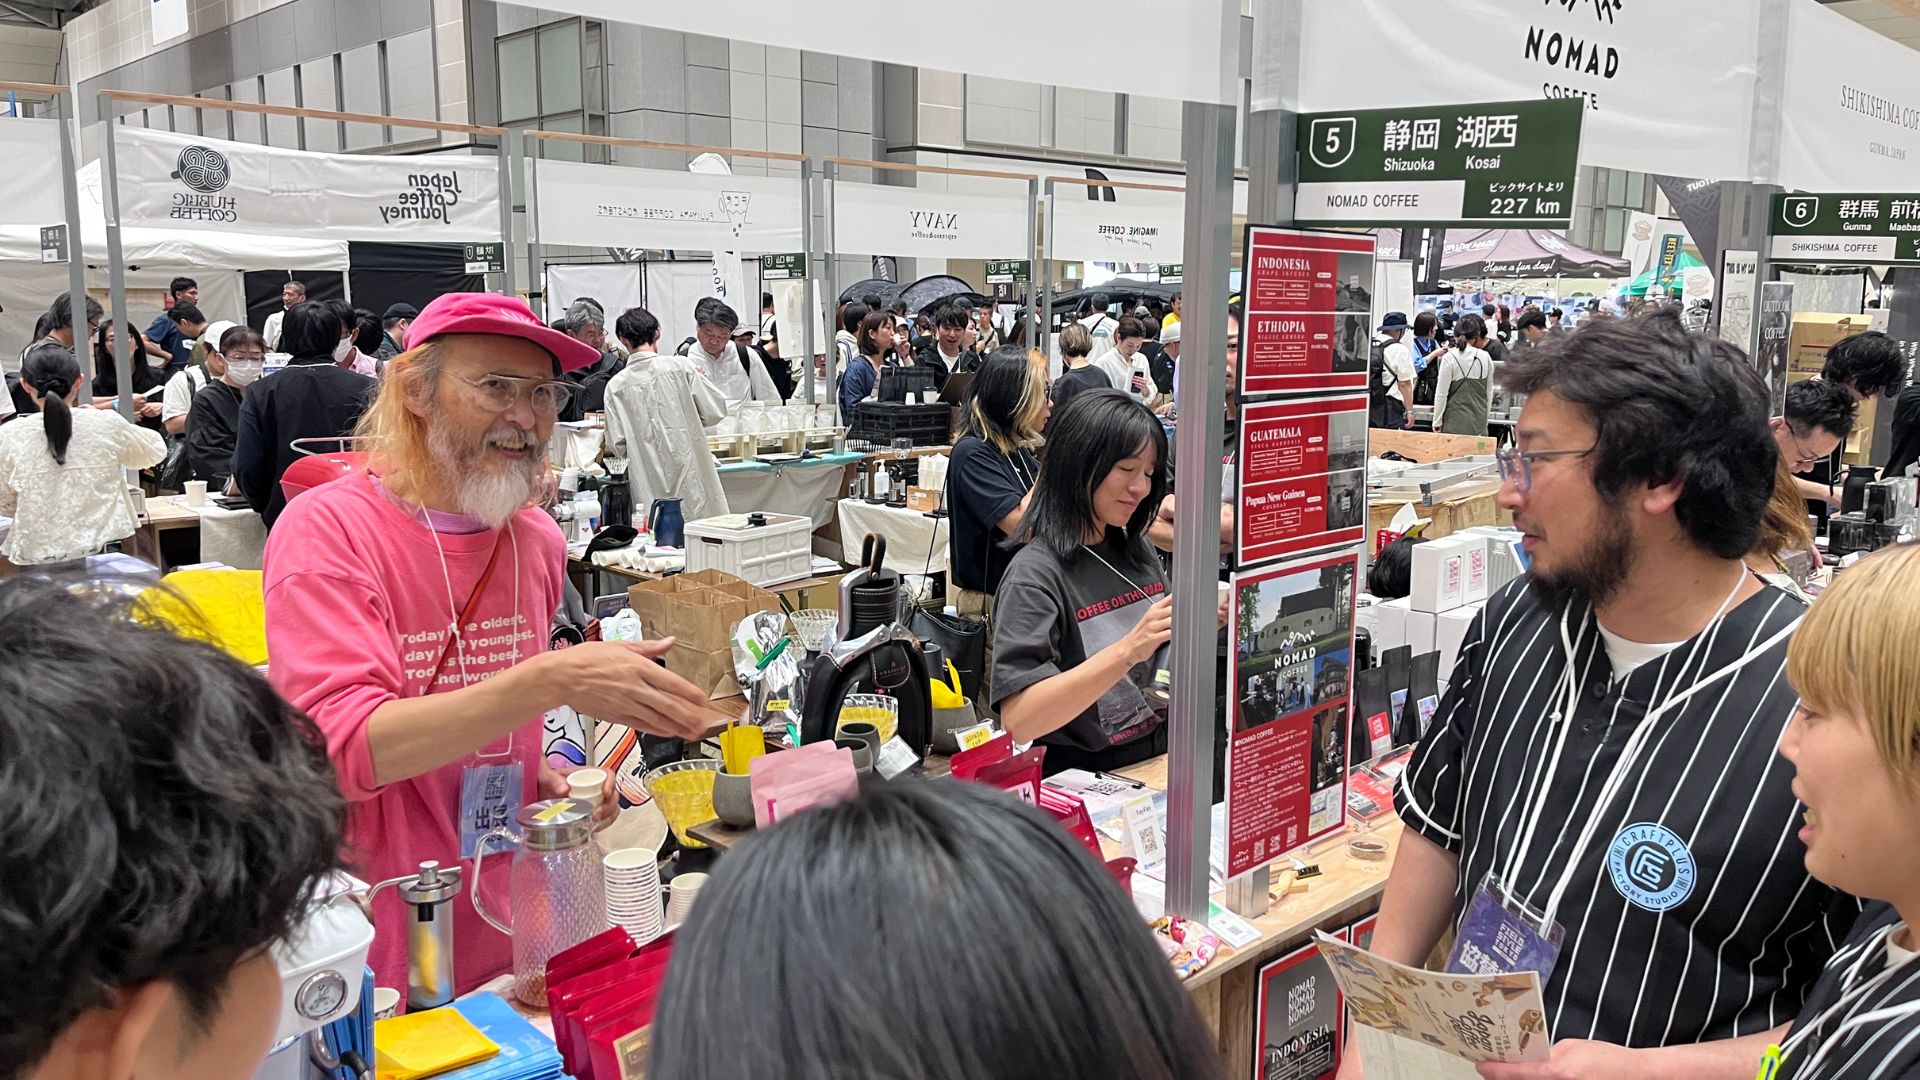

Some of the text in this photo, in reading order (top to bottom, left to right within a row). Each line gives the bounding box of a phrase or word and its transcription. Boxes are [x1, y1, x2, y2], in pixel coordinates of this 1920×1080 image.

[1525, 25, 1618, 79] NOMAD
[1841, 85, 1900, 125] SHIKISHIMA
[1326, 127, 1340, 154] 5
[1383, 115, 1518, 150] 静岡 湖西
[1384, 155, 1500, 172] Shizuoka Kosai
[1489, 181, 1564, 193] ビックサイトより
[1326, 194, 1419, 208] NOMAD COFFEE
[1490, 198, 1560, 216] 227 km
[1795, 202, 1807, 218] 6
[1838, 200, 1880, 219] 群馬
[1843, 223, 1872, 231] Gunma
[1792, 242, 1878, 253] SHIKISHIMA COFFEE
[1258, 256, 1310, 270] INDONESIA
[1482, 260, 1507, 272] Have
[1516, 262, 1531, 273] fun
[1532, 258, 1556, 272] day!
[1763, 300, 1790, 313] OUTDOOR
[1257, 320, 1306, 332] ETHIOPIA
[1764, 327, 1786, 340] COFFEE
[1250, 426, 1302, 442] GUATEMALA
[1246, 489, 1306, 507] Papua New Guinea
[1074, 600, 1111, 622] OFFEE
[1111, 595, 1126, 608] ON
[400, 630, 445, 644] Today
[481, 614, 527, 630] oldest.
[469, 629, 536, 650] youngest.
[458, 654, 487, 665] the
[488, 648, 523, 662] best.
[1274, 646, 1316, 670] NOMAD
[1282, 664, 1308, 678] COFFEE
[1622, 830, 1690, 874] CRAFTPLUS
[1614, 862, 1642, 899] FACTORY
[1645, 890, 1678, 904] STUDIO
[1496, 930, 1522, 955] STYLE
[1500, 923, 1525, 946] FIELD
[1495, 940, 1518, 961] TOKYO
[1288, 976, 1315, 1000] NOMAD
[1288, 988, 1315, 1012] NOMAD
[1288, 1000, 1315, 1026] NOMAD
[1467, 1010, 1495, 1052] Japan
[1271, 1024, 1330, 1063] INDONESIA
